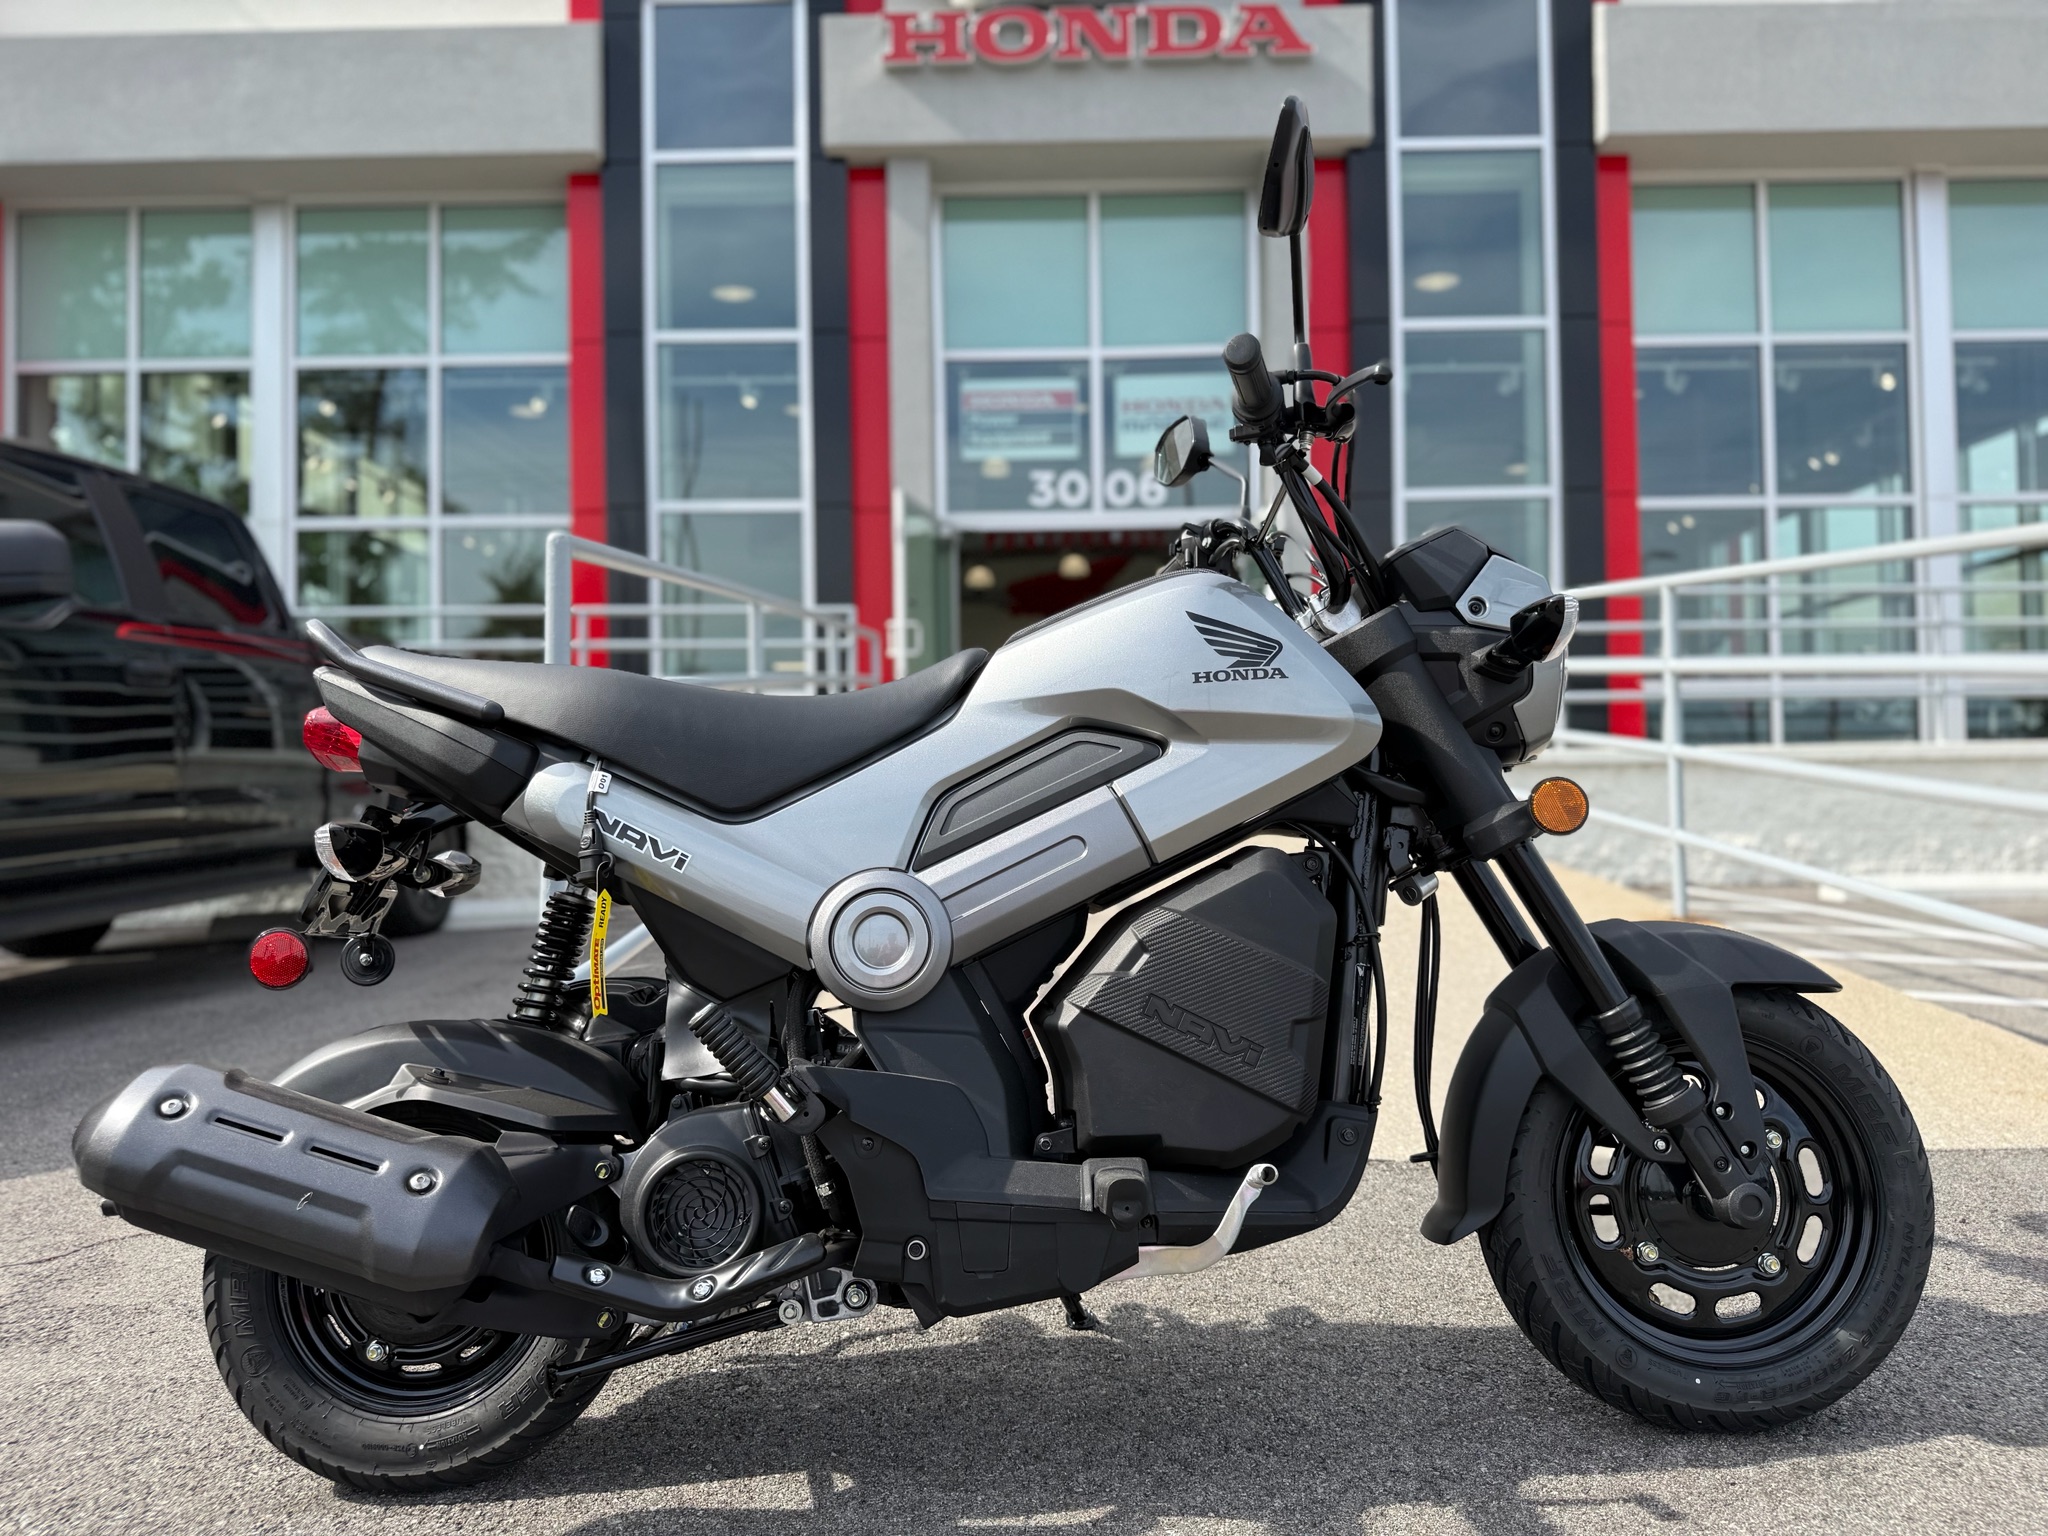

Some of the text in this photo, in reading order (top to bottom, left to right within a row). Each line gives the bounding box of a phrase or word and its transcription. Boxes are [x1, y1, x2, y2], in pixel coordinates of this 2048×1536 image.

[883, 4, 1315, 64] HONDA
[1192, 668, 1289, 684] HONDA
[598, 896, 607, 928] READY
[1829, 1061, 1899, 1147] MRF
